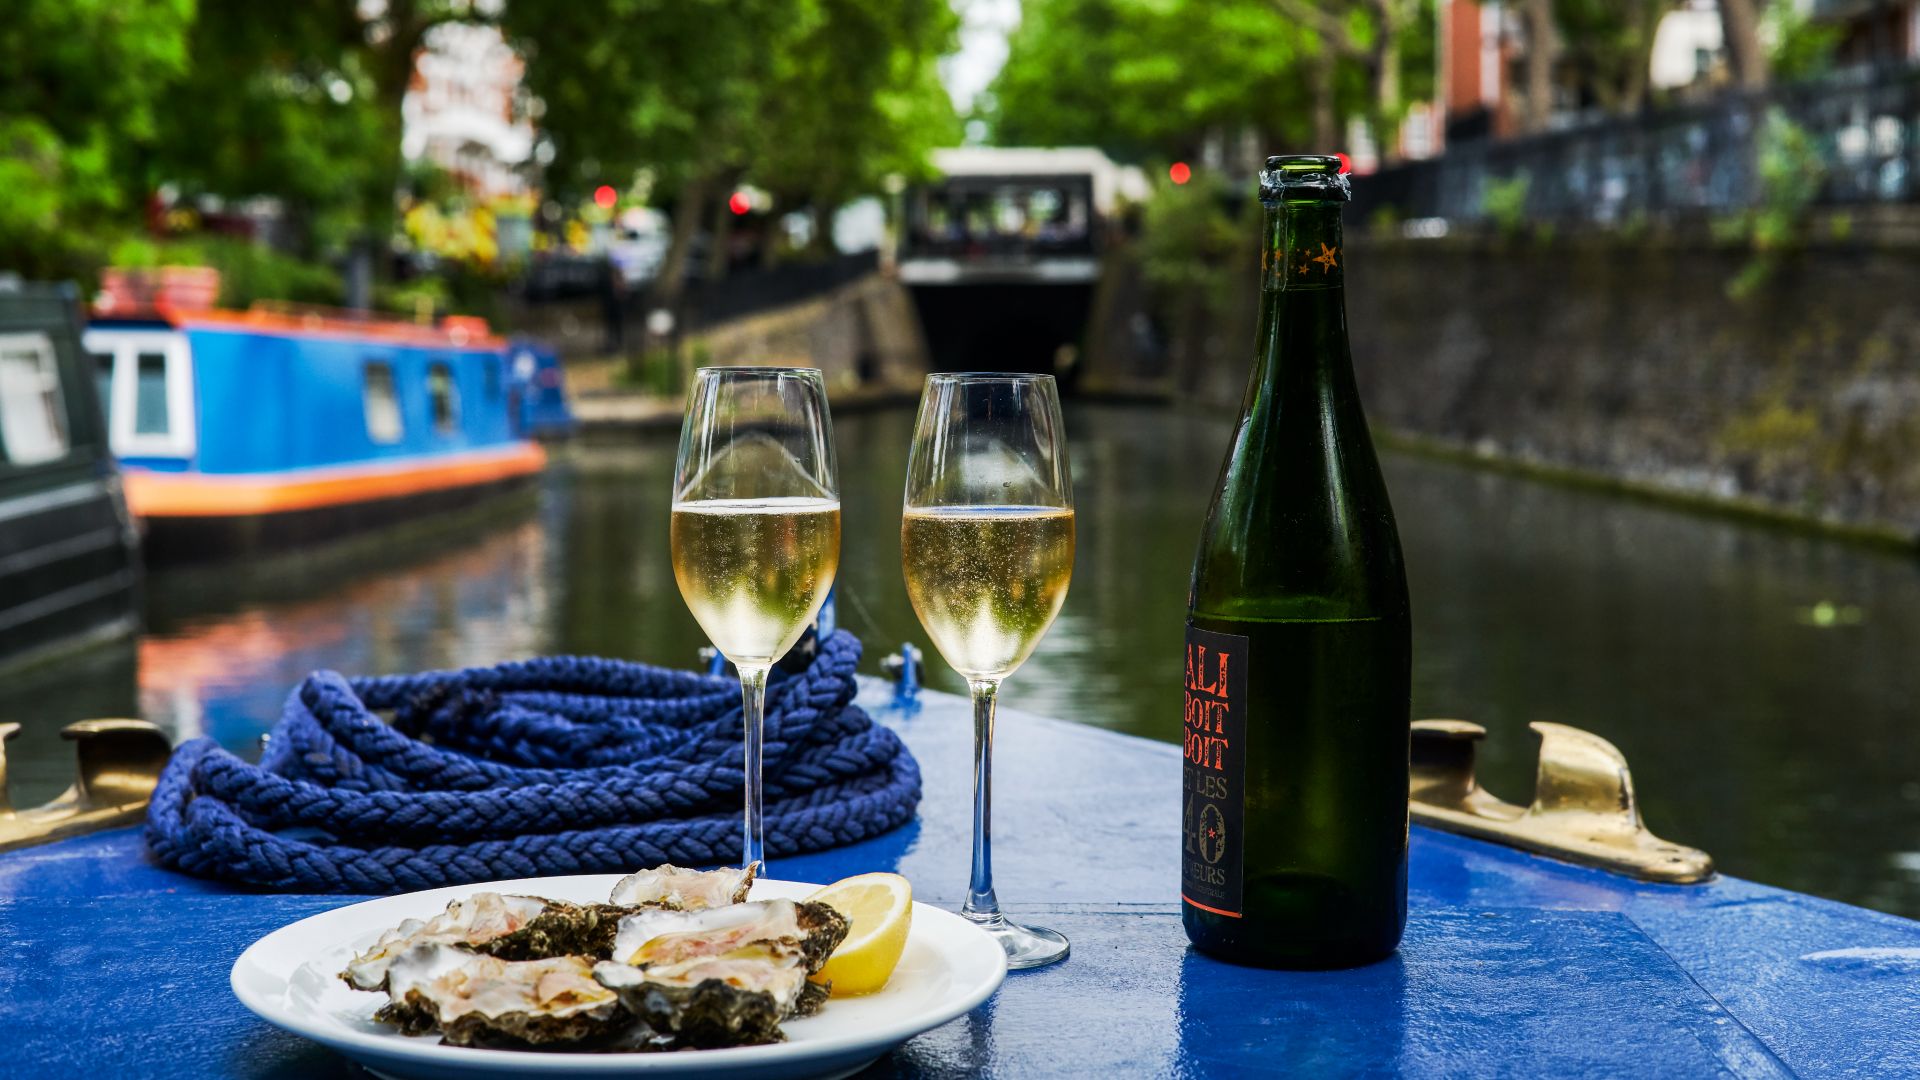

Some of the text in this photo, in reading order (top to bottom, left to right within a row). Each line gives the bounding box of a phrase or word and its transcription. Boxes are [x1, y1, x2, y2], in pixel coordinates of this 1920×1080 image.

[1184, 643, 1230, 699] ALI
[1184, 690, 1230, 735] BOIT
[1184, 726, 1229, 771] BOIT
[1196, 770, 1228, 800] LES
[1183, 793, 1226, 864] 40
